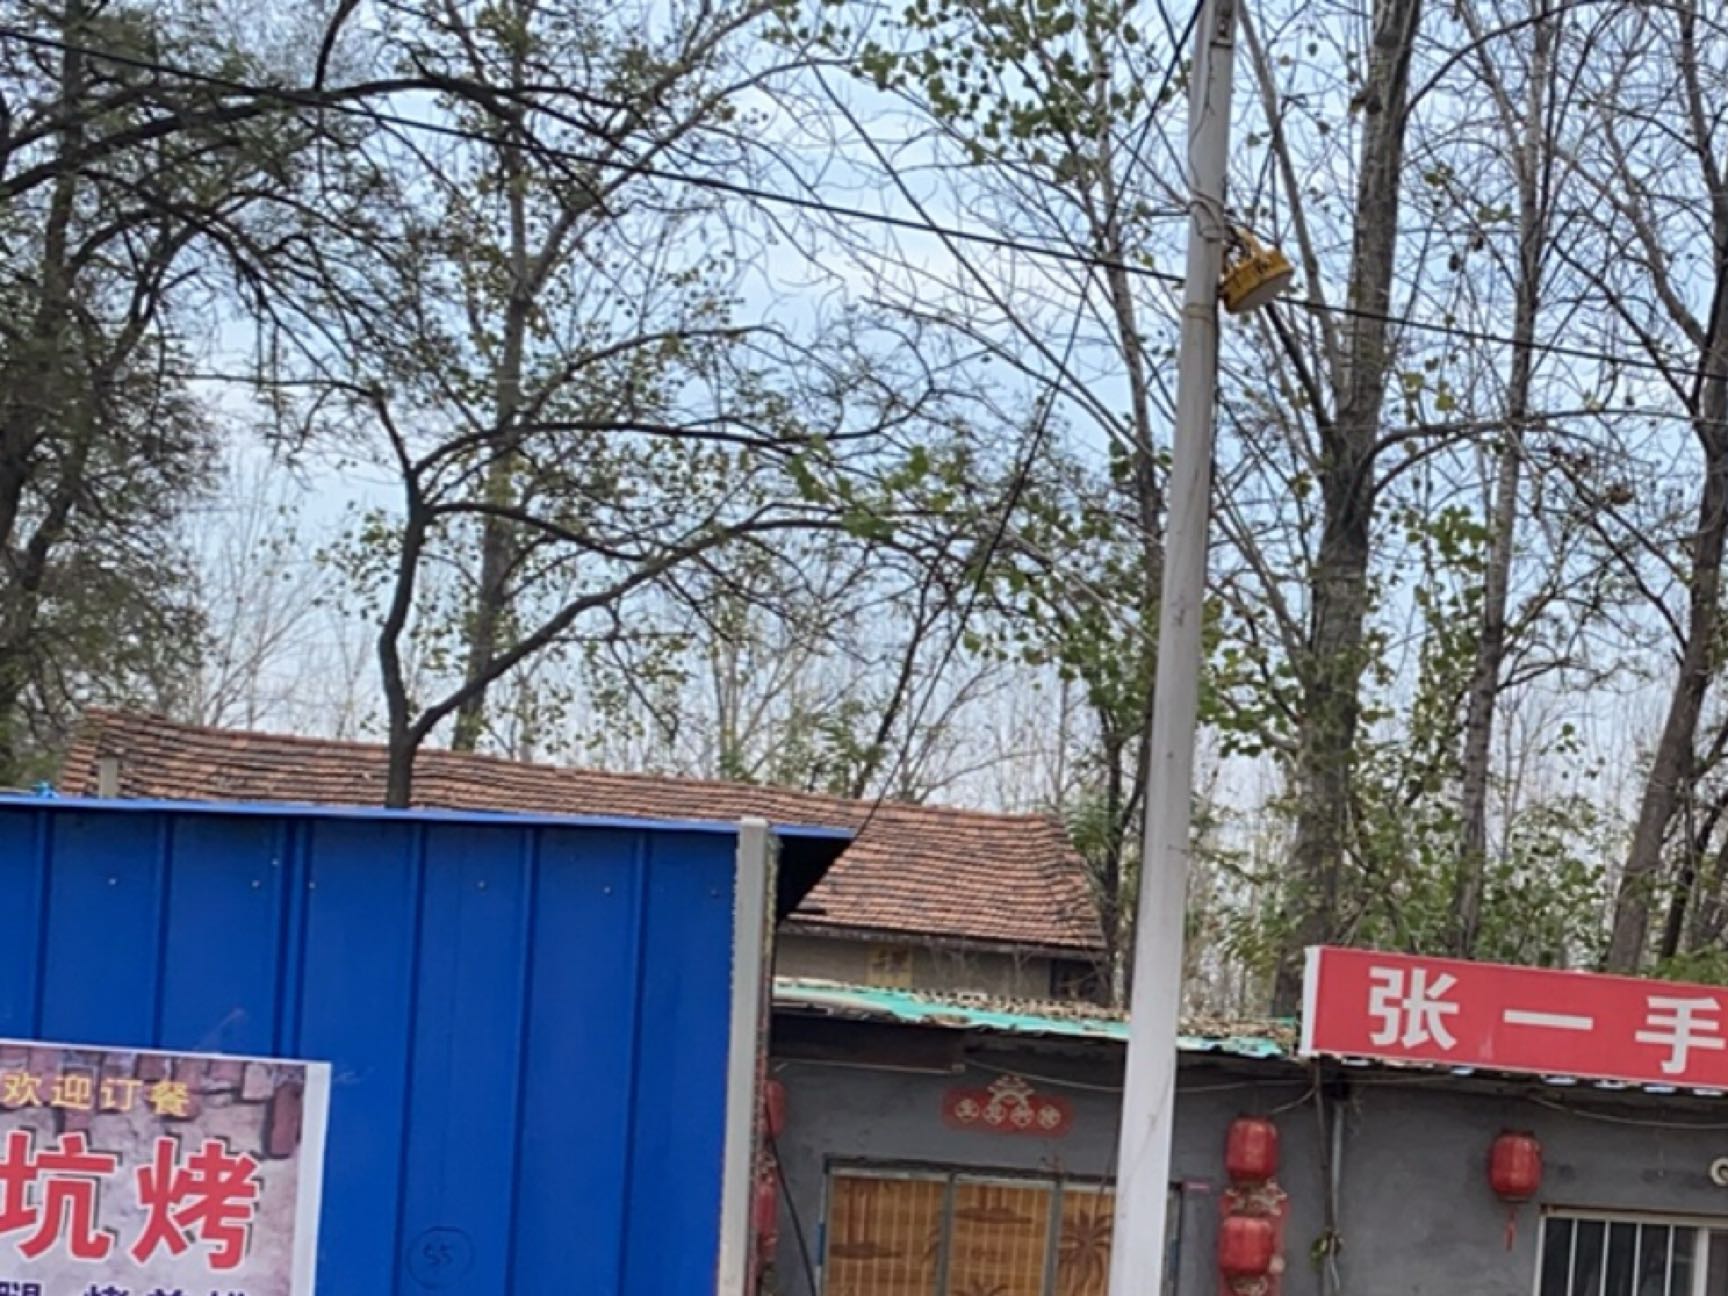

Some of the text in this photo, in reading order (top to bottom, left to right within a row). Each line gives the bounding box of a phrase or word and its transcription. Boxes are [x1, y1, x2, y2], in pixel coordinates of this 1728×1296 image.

[3, 1073, 190, 1116] 欢迎订餐
[0, 1131, 260, 1270] 坑烤
